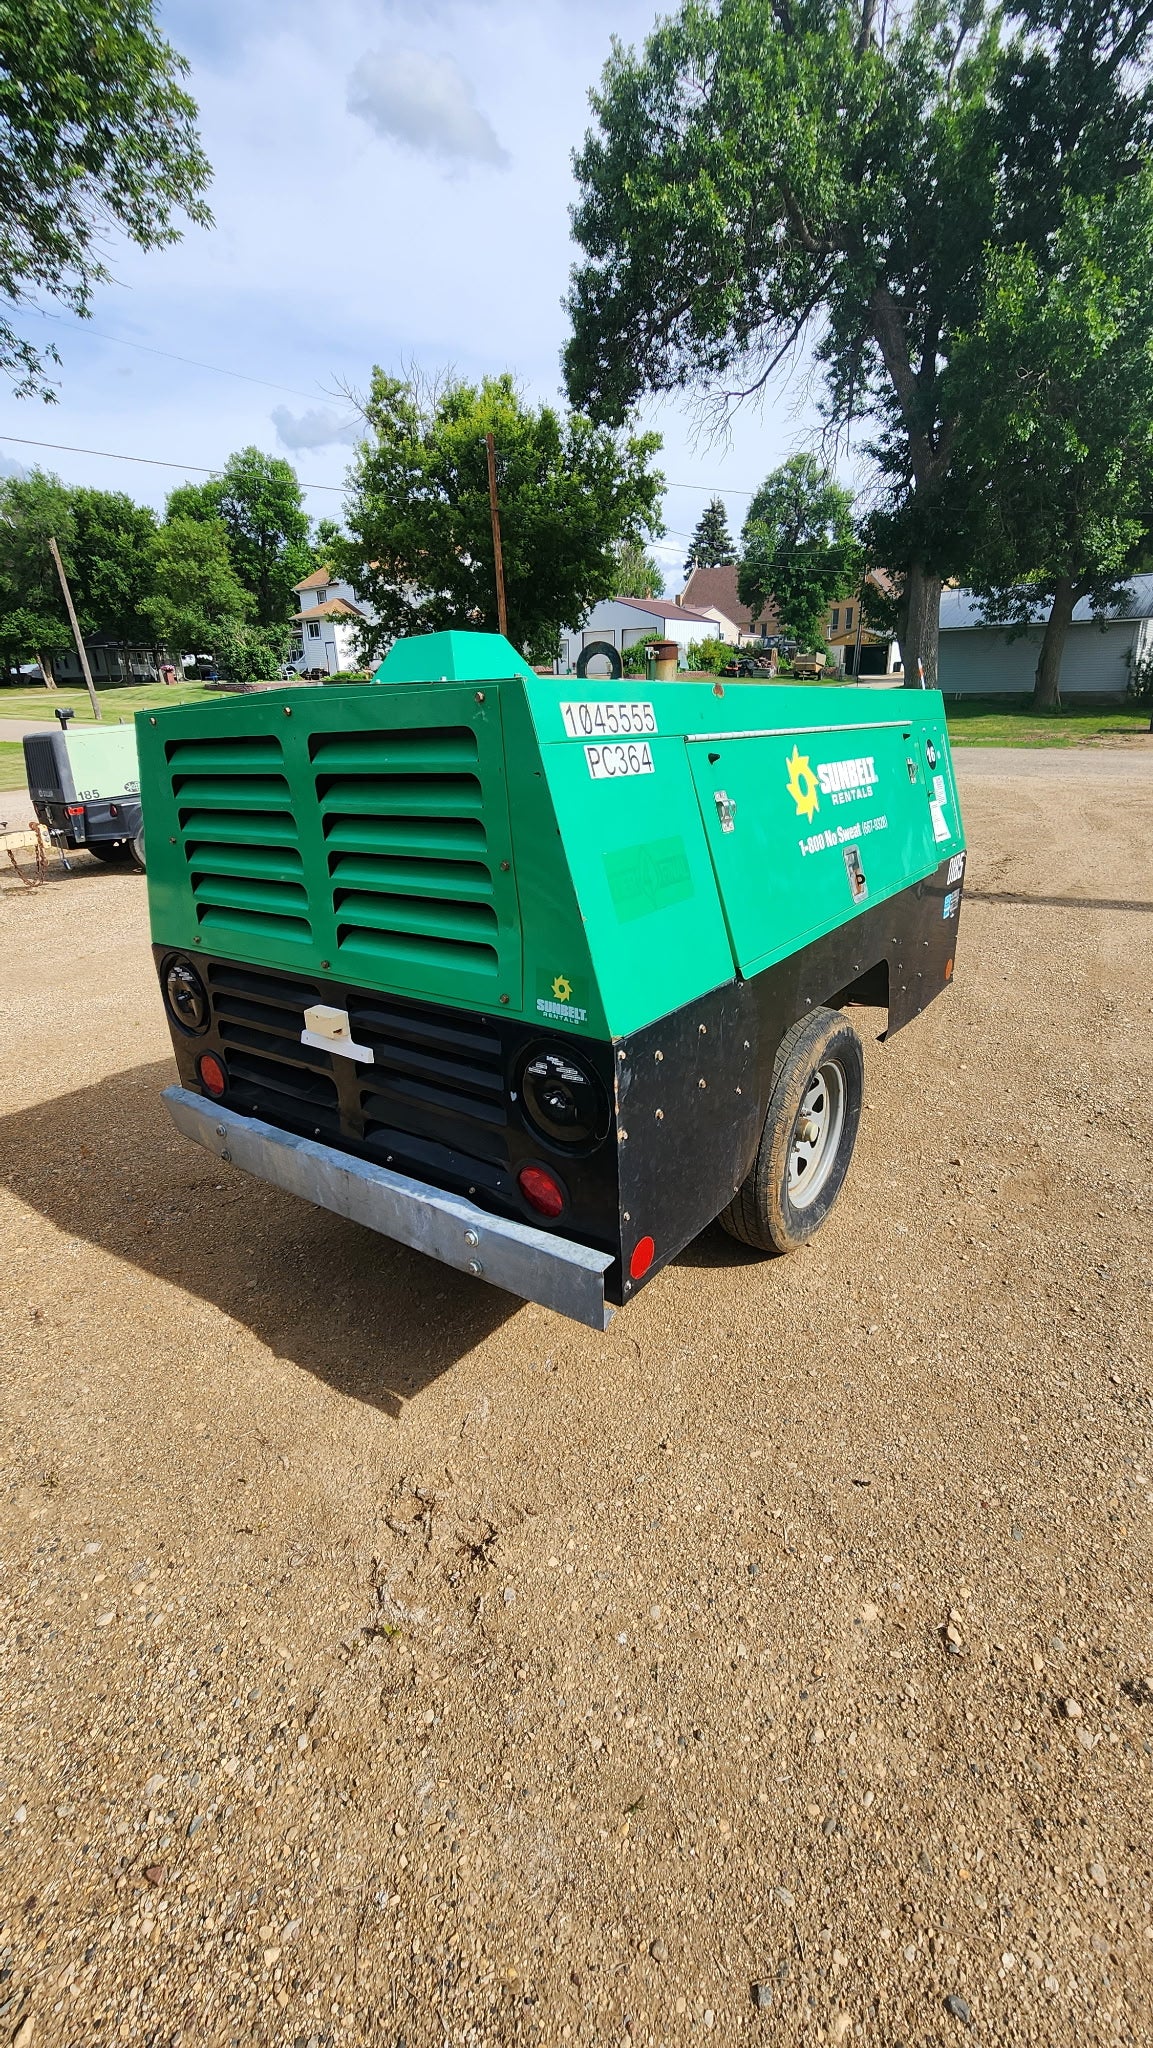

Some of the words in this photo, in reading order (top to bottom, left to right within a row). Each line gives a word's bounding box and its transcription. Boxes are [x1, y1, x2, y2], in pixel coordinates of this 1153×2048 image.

[565, 703, 655, 735] 1045555
[586, 743, 652, 777] PC364
[926, 746, 936, 763] 16
[817, 757, 876, 794] SUNBELT
[78, 789, 100, 800] 185
[831, 785, 874, 805] RENTALS
[798, 834, 825, 856] 1-800
[824, 829, 838, 848] No
[837, 822, 862, 843] Sweat
[536, 998, 587, 1021] SUNBELT
[542, 1011, 579, 1025] RENTALS
